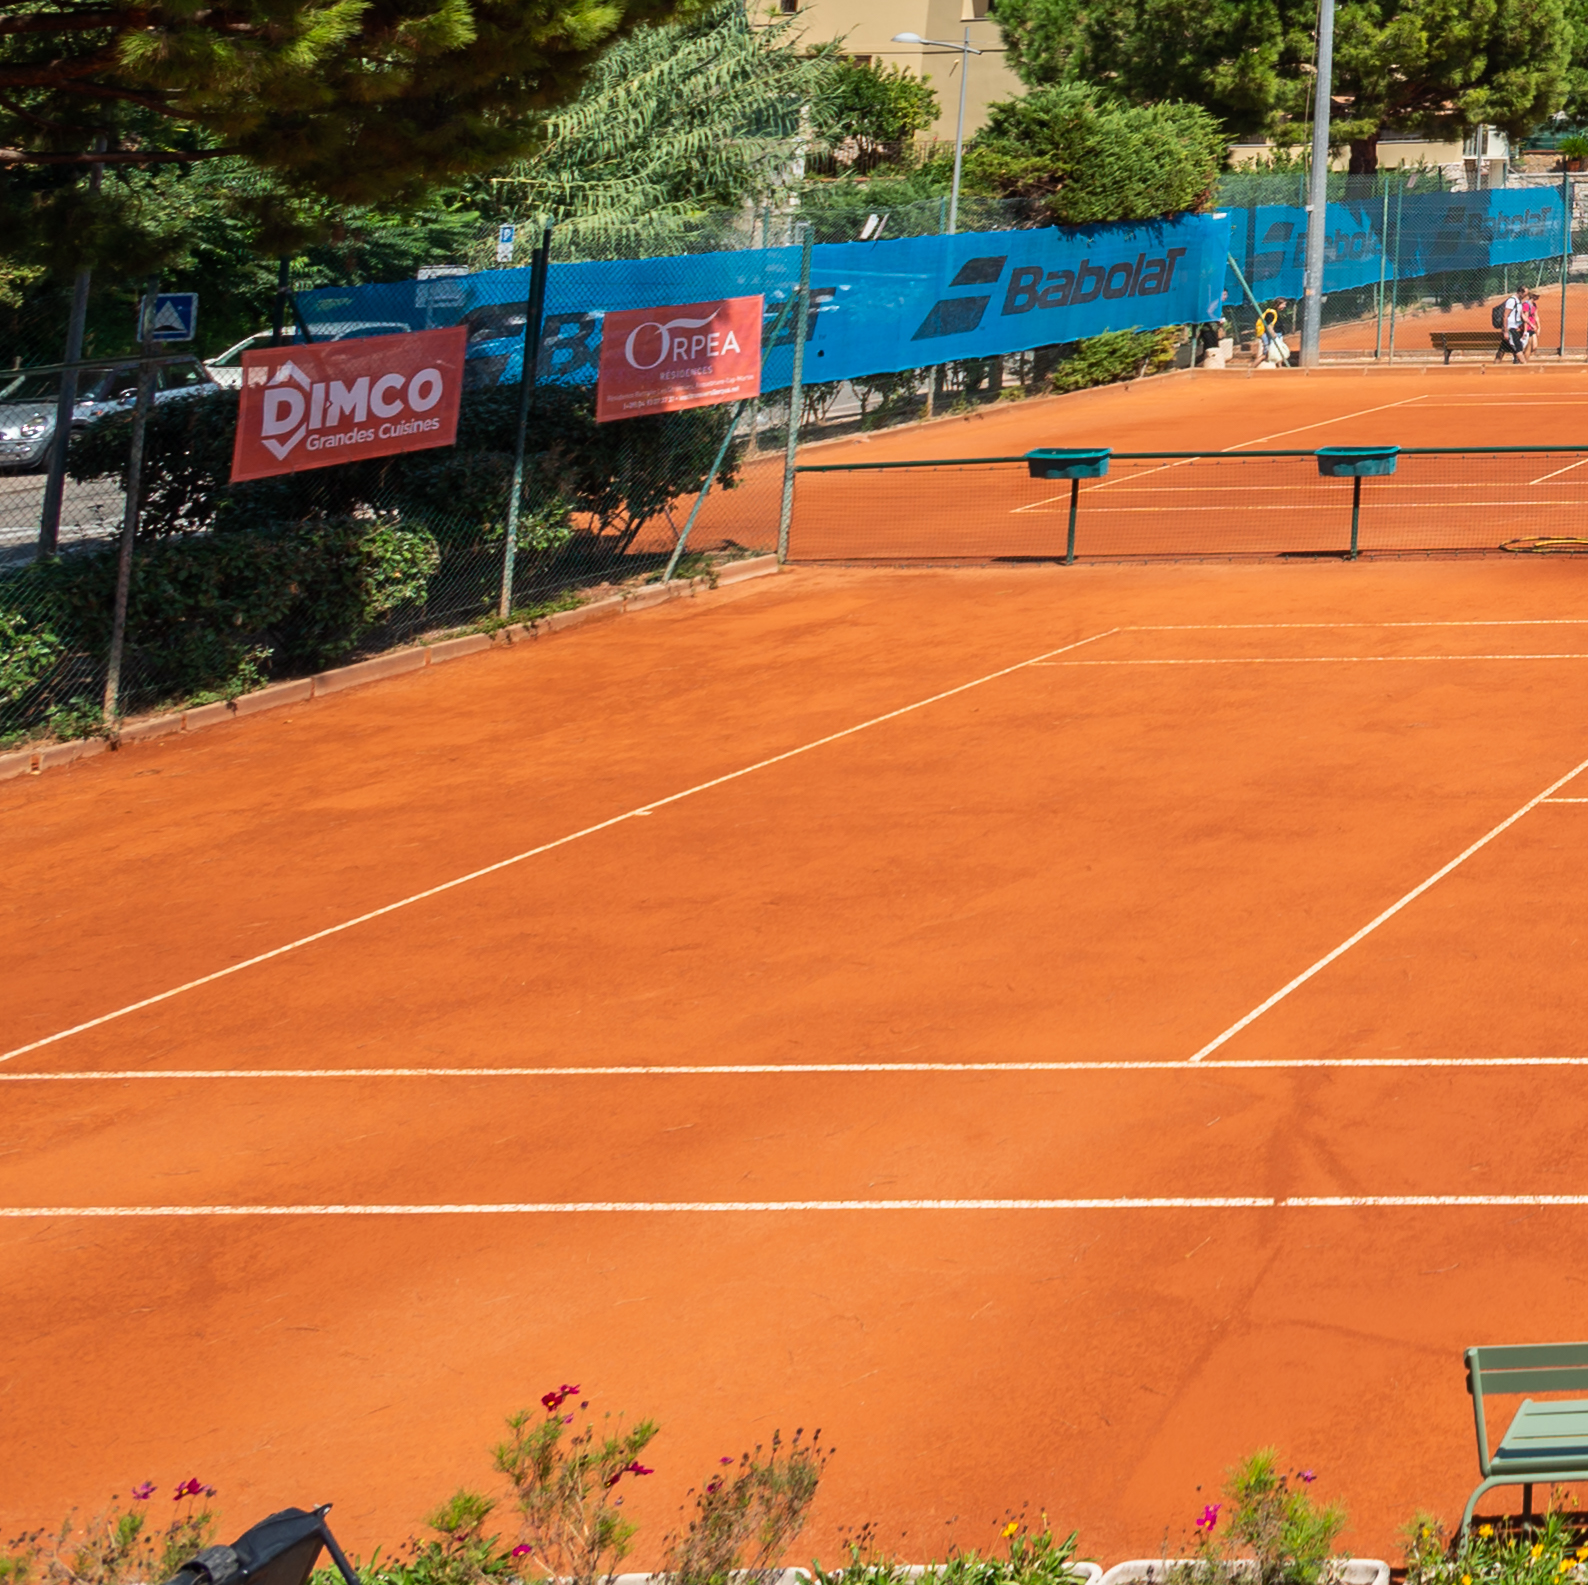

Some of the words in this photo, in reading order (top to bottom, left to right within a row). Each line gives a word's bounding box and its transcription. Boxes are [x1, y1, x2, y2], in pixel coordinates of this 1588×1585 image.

[625, 306, 741, 370] ORPEA
[261, 368, 443, 437] DIMCO
[306, 427, 375, 451] Grandes
[378, 417, 440, 440] Cuisines
